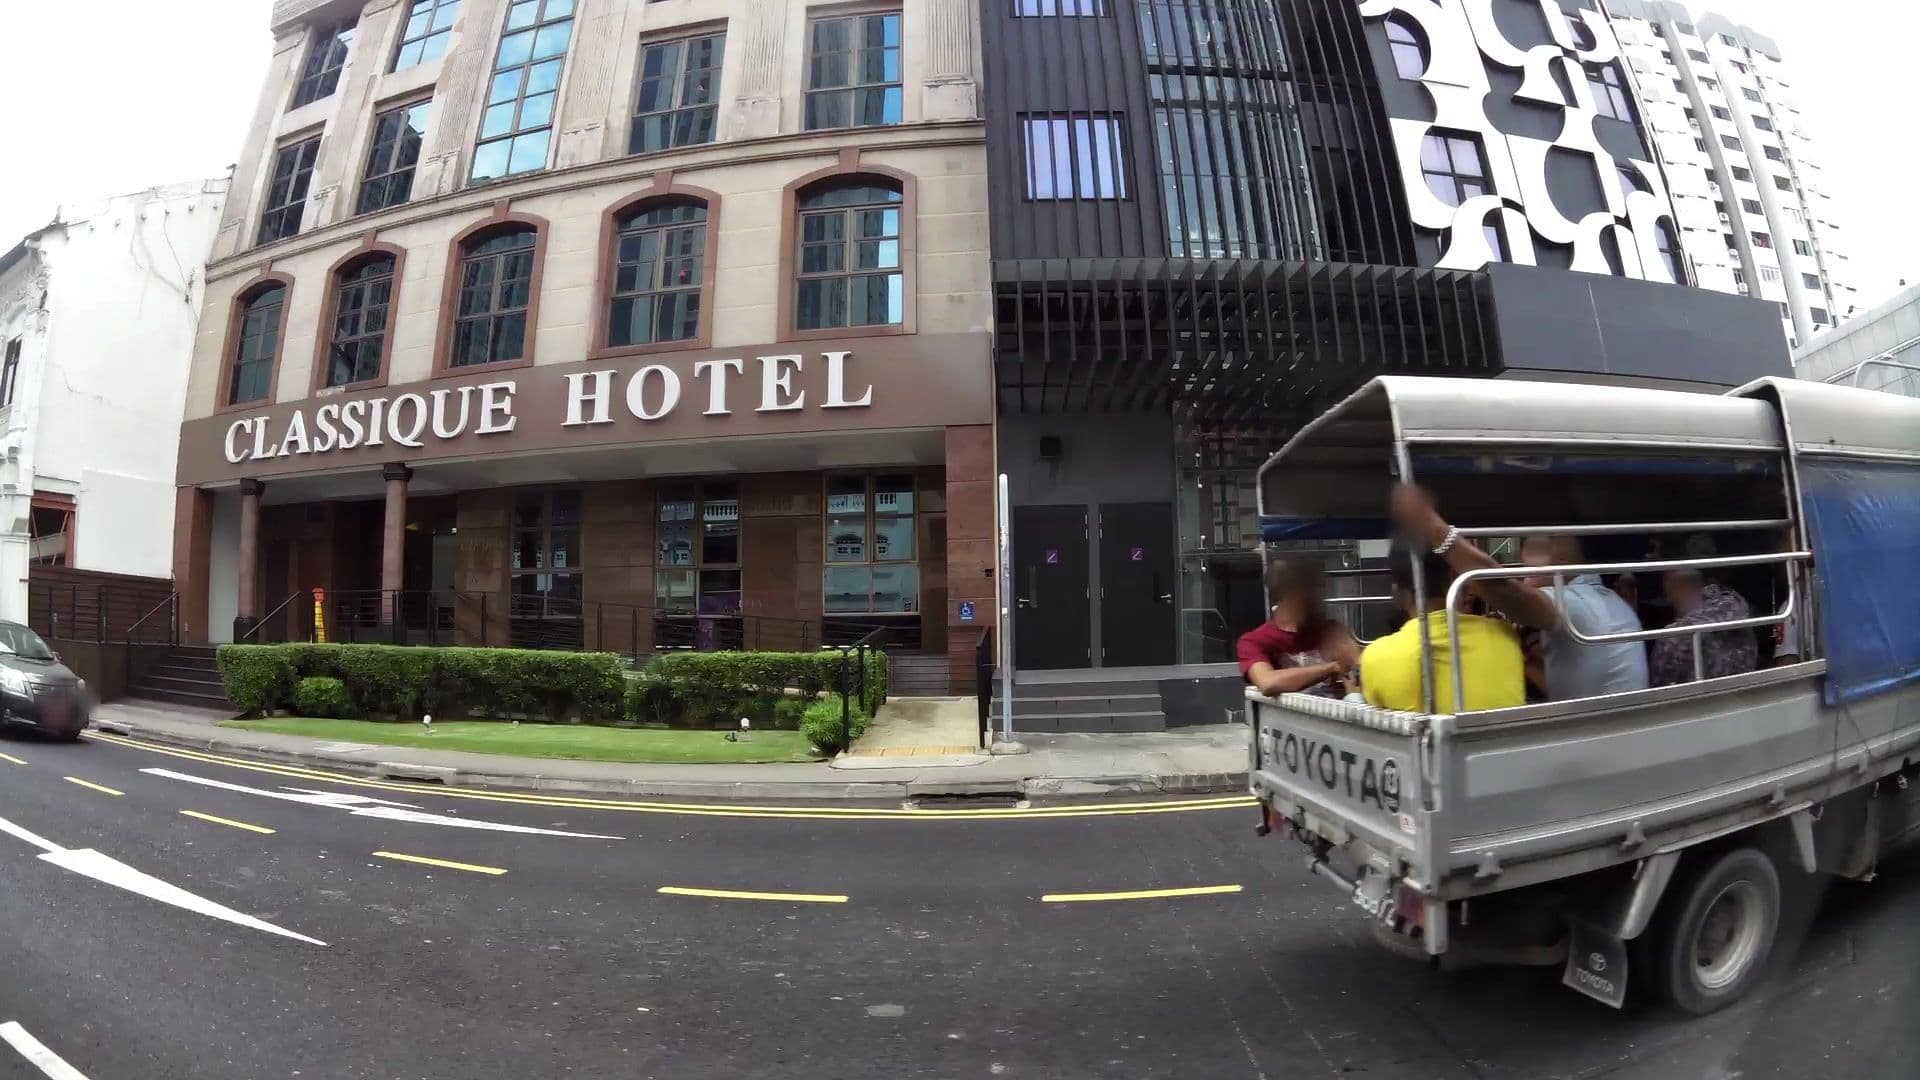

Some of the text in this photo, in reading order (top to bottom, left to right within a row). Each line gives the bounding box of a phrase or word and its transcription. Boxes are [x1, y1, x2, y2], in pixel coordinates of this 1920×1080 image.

[224, 351, 873, 463] CLASSIQUE HOTEL
[1271, 728, 1384, 810] TOYOTA
[1575, 967, 1615, 996] TOYOTA
